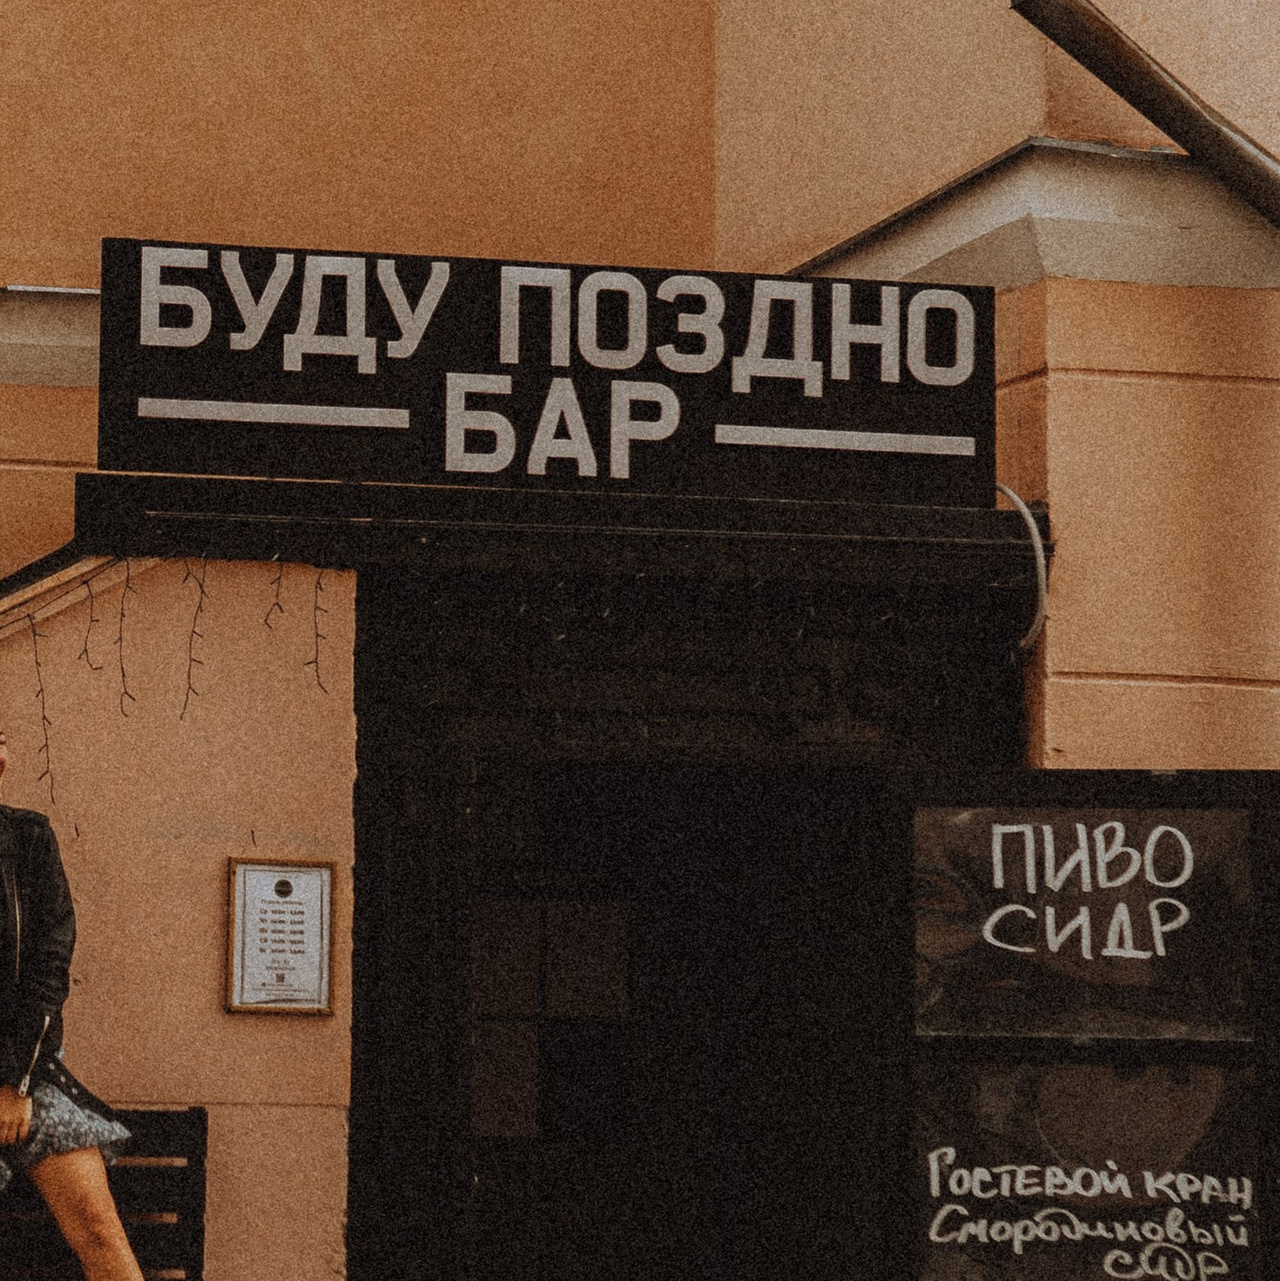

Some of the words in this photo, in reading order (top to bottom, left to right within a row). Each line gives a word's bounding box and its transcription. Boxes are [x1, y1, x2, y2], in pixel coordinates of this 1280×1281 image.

[139, 245, 451, 375] БУДУ
[499, 264, 976, 399] ПОЗДНО
[444, 371, 682, 480] БАР
[990, 820, 1195, 895] ПИВО
[981, 897, 1191, 961] СИДР
